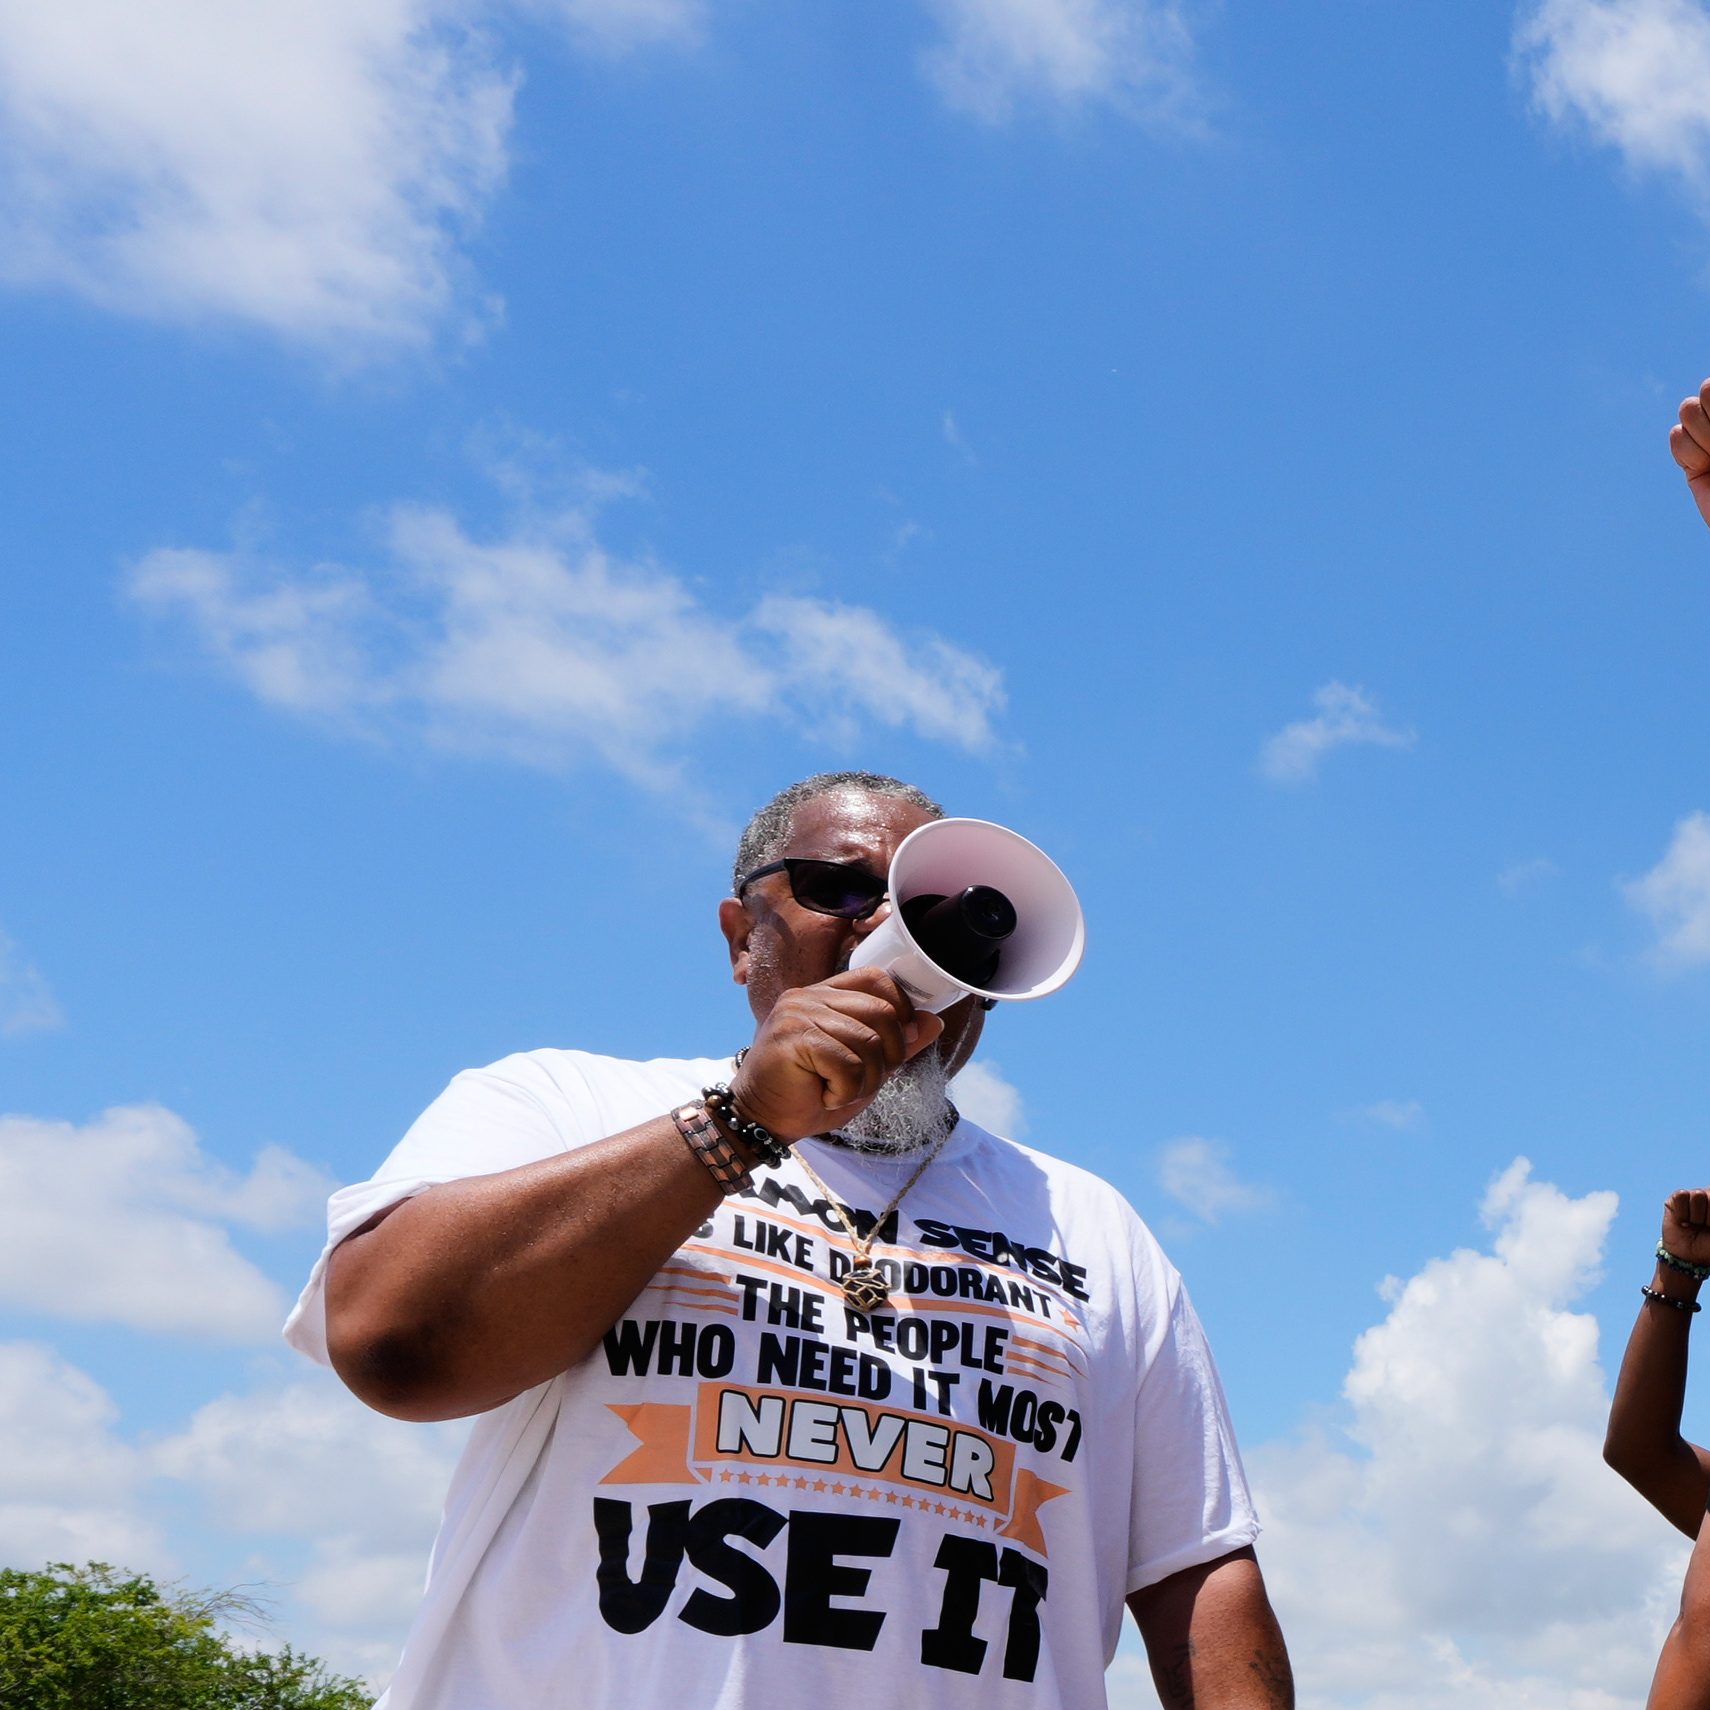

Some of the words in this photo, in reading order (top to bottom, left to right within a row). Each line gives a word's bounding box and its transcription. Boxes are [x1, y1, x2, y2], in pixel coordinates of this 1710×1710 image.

[733, 1214, 814, 1272] LIKE
[829, 1248, 1053, 1318] DODORANT
[913, 1219, 1090, 1302] SENSE
[604, 1319, 735, 1379] WHO
[757, 1331, 892, 1401] NEED
[912, 1367, 960, 1417] IT
[735, 1275, 825, 1334] THE
[844, 1306, 1009, 1375] PEOPLE
[716, 1389, 995, 1503] NEVER
[593, 1497, 902, 1651] USE
[920, 1533, 1049, 1684] IT
